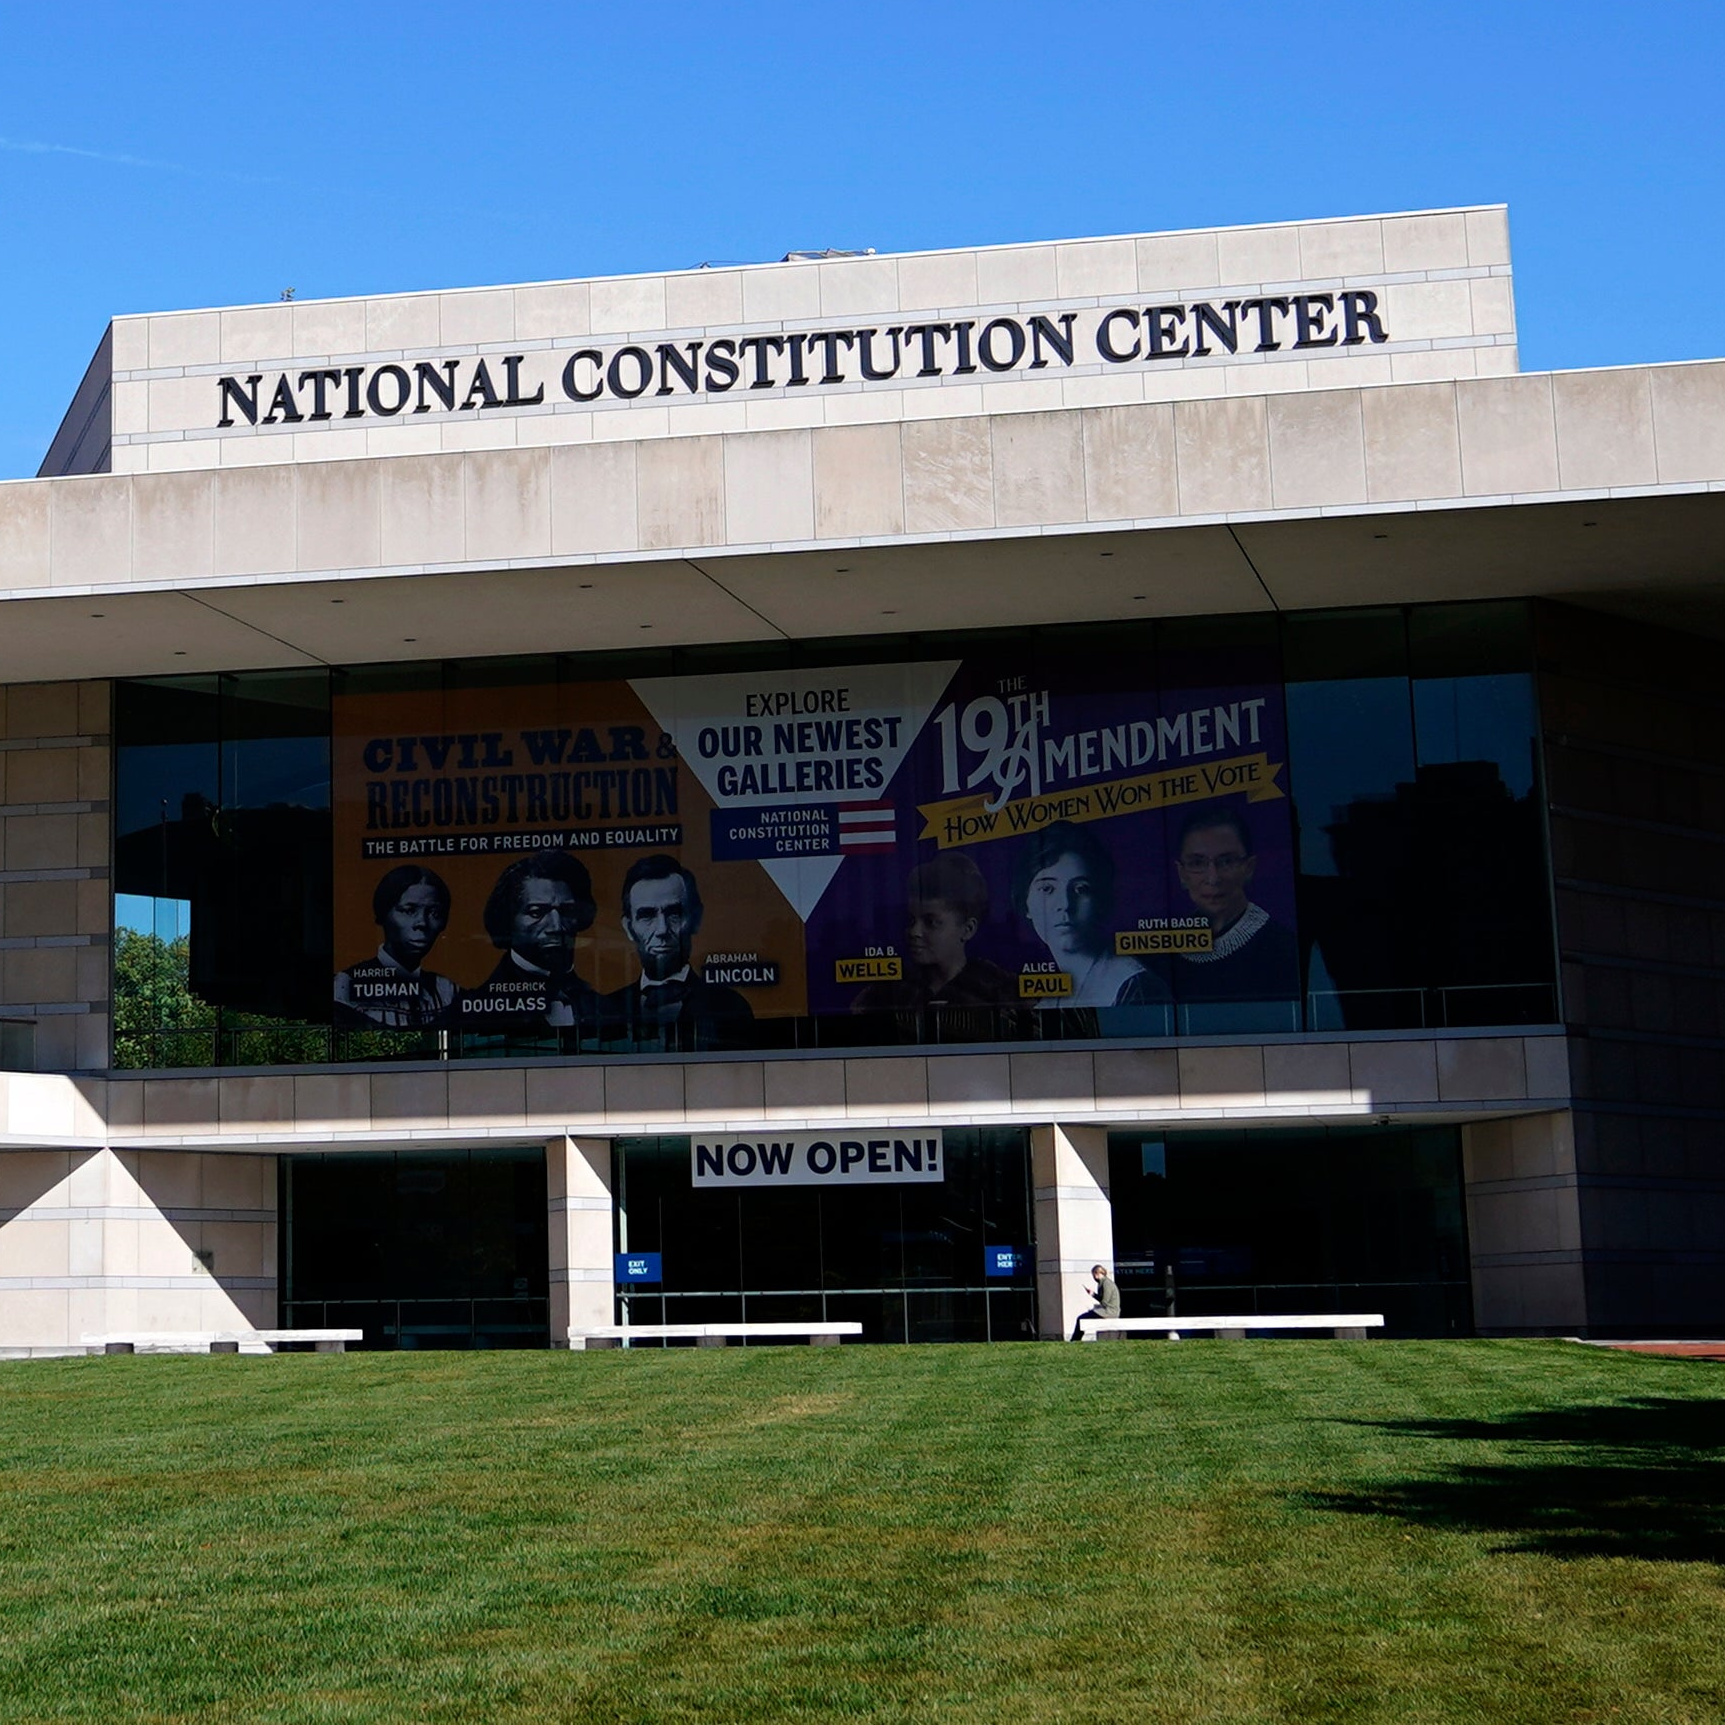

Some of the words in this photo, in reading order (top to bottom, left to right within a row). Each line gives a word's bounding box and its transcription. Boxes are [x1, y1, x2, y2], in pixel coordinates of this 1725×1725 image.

[216, 353, 545, 428] NATIONAL
[561, 313, 1076, 401] CONSTITUTION
[1095, 289, 1388, 362] CENTER
[997, 675, 1027, 693] THE
[745, 688, 851, 718] EXPLORE
[697, 725, 763, 759] OUR
[773, 716, 903, 755] NEWEST
[363, 731, 513, 773] CIVIL
[520, 725, 647, 763] WAR
[655, 731, 677, 760] &
[983, 697, 1267, 814] AMENDMENT
[716, 757, 885, 797] GALLERIES
[365, 765, 679, 831] RECONSTRUCTION
[943, 812, 1001, 843] HOW
[1004, 792, 1091, 830] WOMEN
[1093, 784, 1152, 815] WON
[1157, 774, 1200, 798] THE
[1205, 762, 1262, 793] VOTE
[760, 808, 830, 824] NATIONAL
[366, 839, 396, 855] THE
[399, 836, 456, 854] BATTLE
[459, 835, 490, 851] FOR
[493, 832, 565, 849] FREEDOM
[569, 830, 600, 846] AND
[603, 826, 679, 845] EQUALITY
[728, 823, 831, 841] CONSTITUTION
[775, 837, 831, 853] CENTER
[1137, 917, 1168, 930] RUTH
[1171, 915, 1209, 928] BADER
[1119, 931, 1210, 951] GINSBURG
[705, 952, 758, 965] ABRAHAM
[864, 946, 884, 958] IDA
[887, 946, 898, 957] B.
[353, 967, 397, 979] HARRIET
[705, 967, 775, 984] LINCOLN
[838, 960, 898, 979] WELLS
[1022, 961, 1056, 974] ALICE
[353, 981, 419, 998] TUBMAN
[489, 981, 547, 994] FREDERICK
[1023, 977, 1069, 995] PAUL
[461, 995, 547, 1014] DOUGLASS
[696, 1141, 795, 1177] NOW
[806, 1138, 939, 1174] OPEN!
